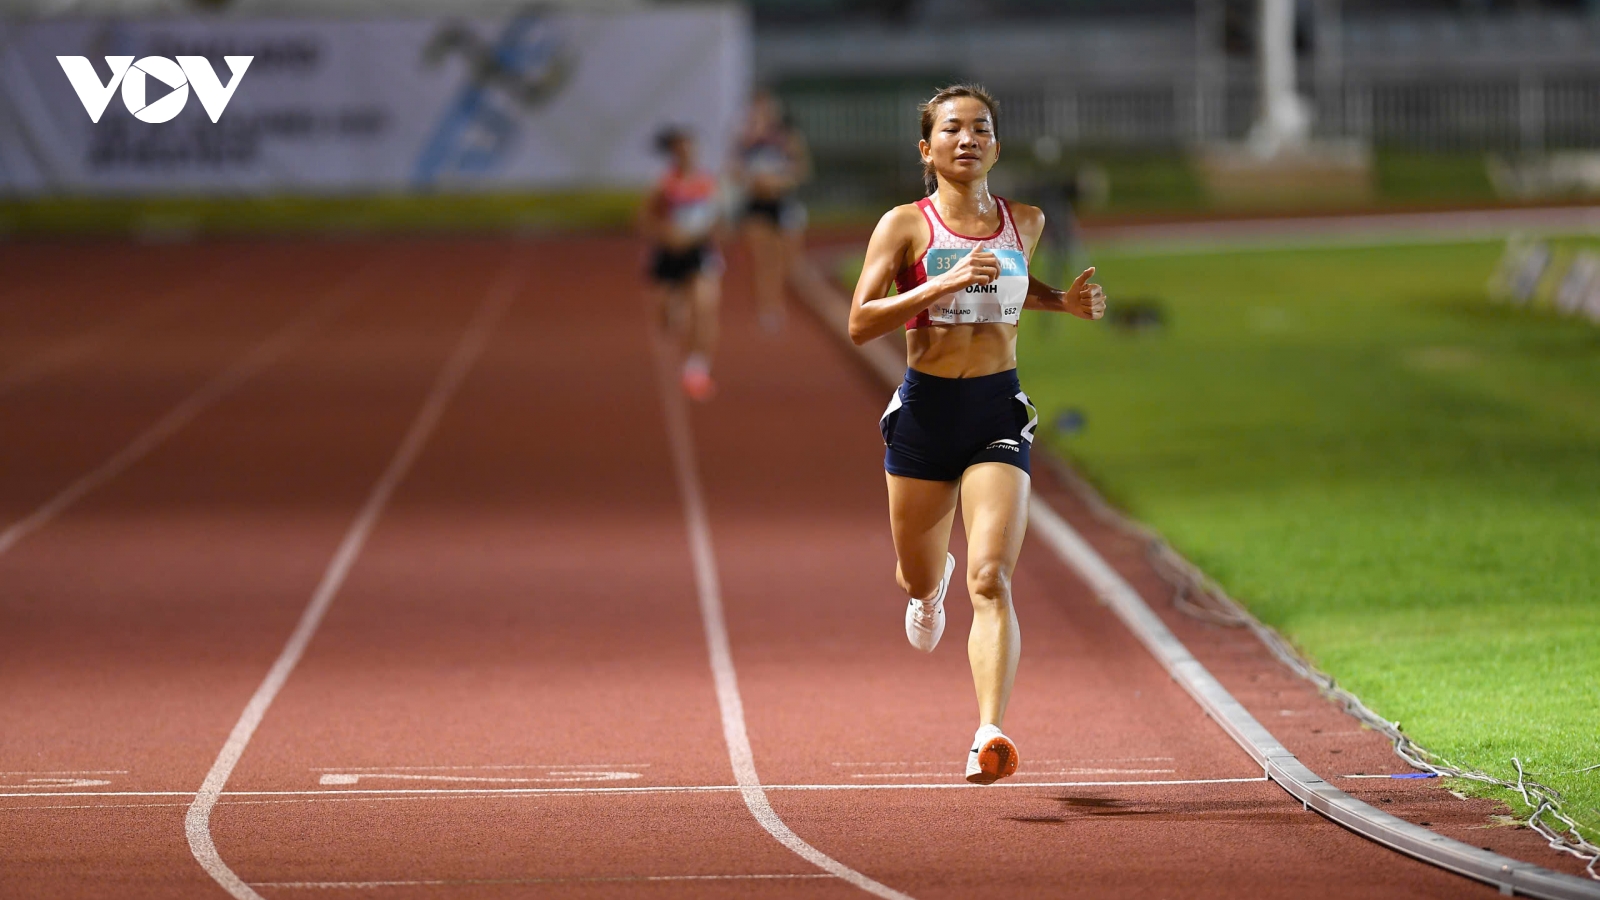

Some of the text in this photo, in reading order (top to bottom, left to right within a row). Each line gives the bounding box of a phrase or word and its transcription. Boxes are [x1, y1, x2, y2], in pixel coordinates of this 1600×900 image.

[936, 253, 957, 270] 33rd
[965, 284, 998, 294] OANH
[1004, 307, 1017, 316] 652
